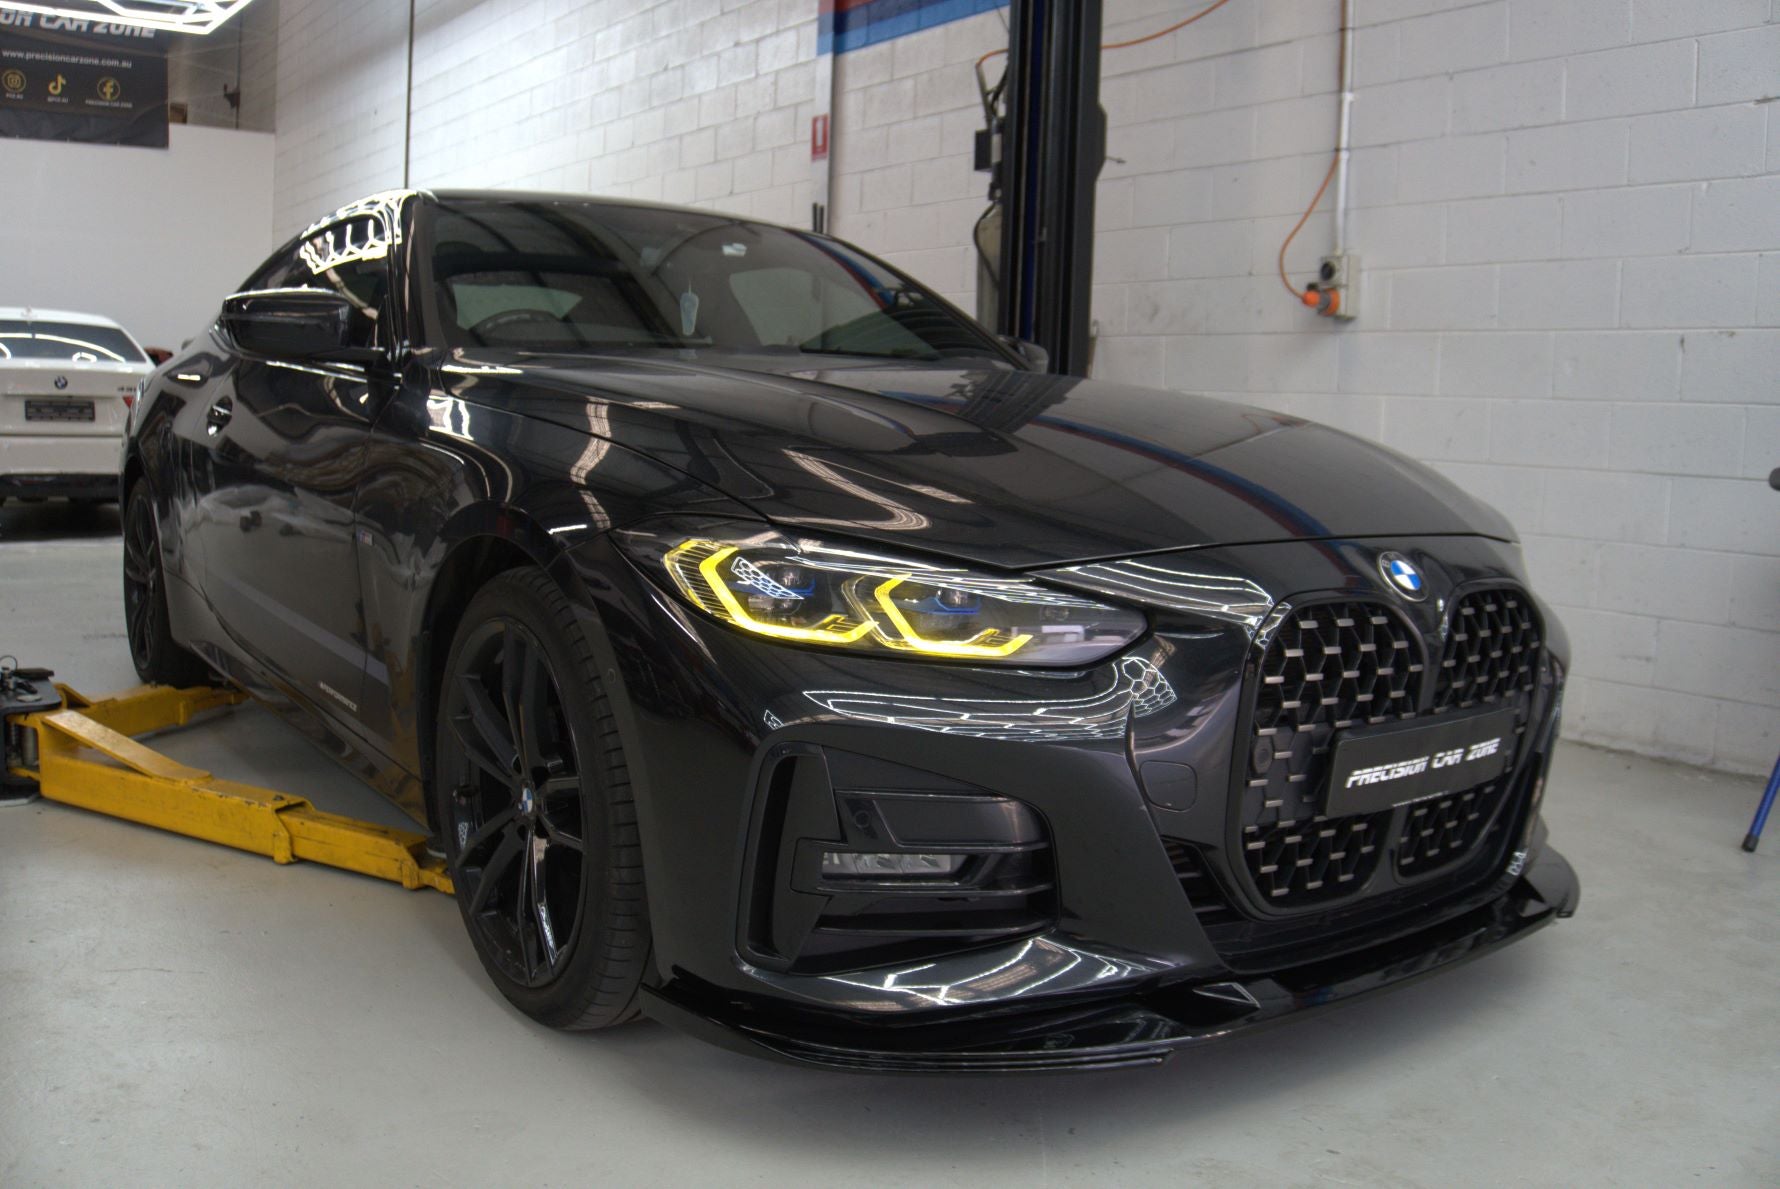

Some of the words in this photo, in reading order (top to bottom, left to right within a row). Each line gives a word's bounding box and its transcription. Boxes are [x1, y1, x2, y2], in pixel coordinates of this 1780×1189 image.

[40, 13, 89, 33] CAR
[2, 50, 132, 69] www.precisioncarzone.com.au
[1345, 756, 1430, 788] PRECISION
[1431, 748, 1465, 769] CAR
[1466, 738, 1502, 761] ZONE
